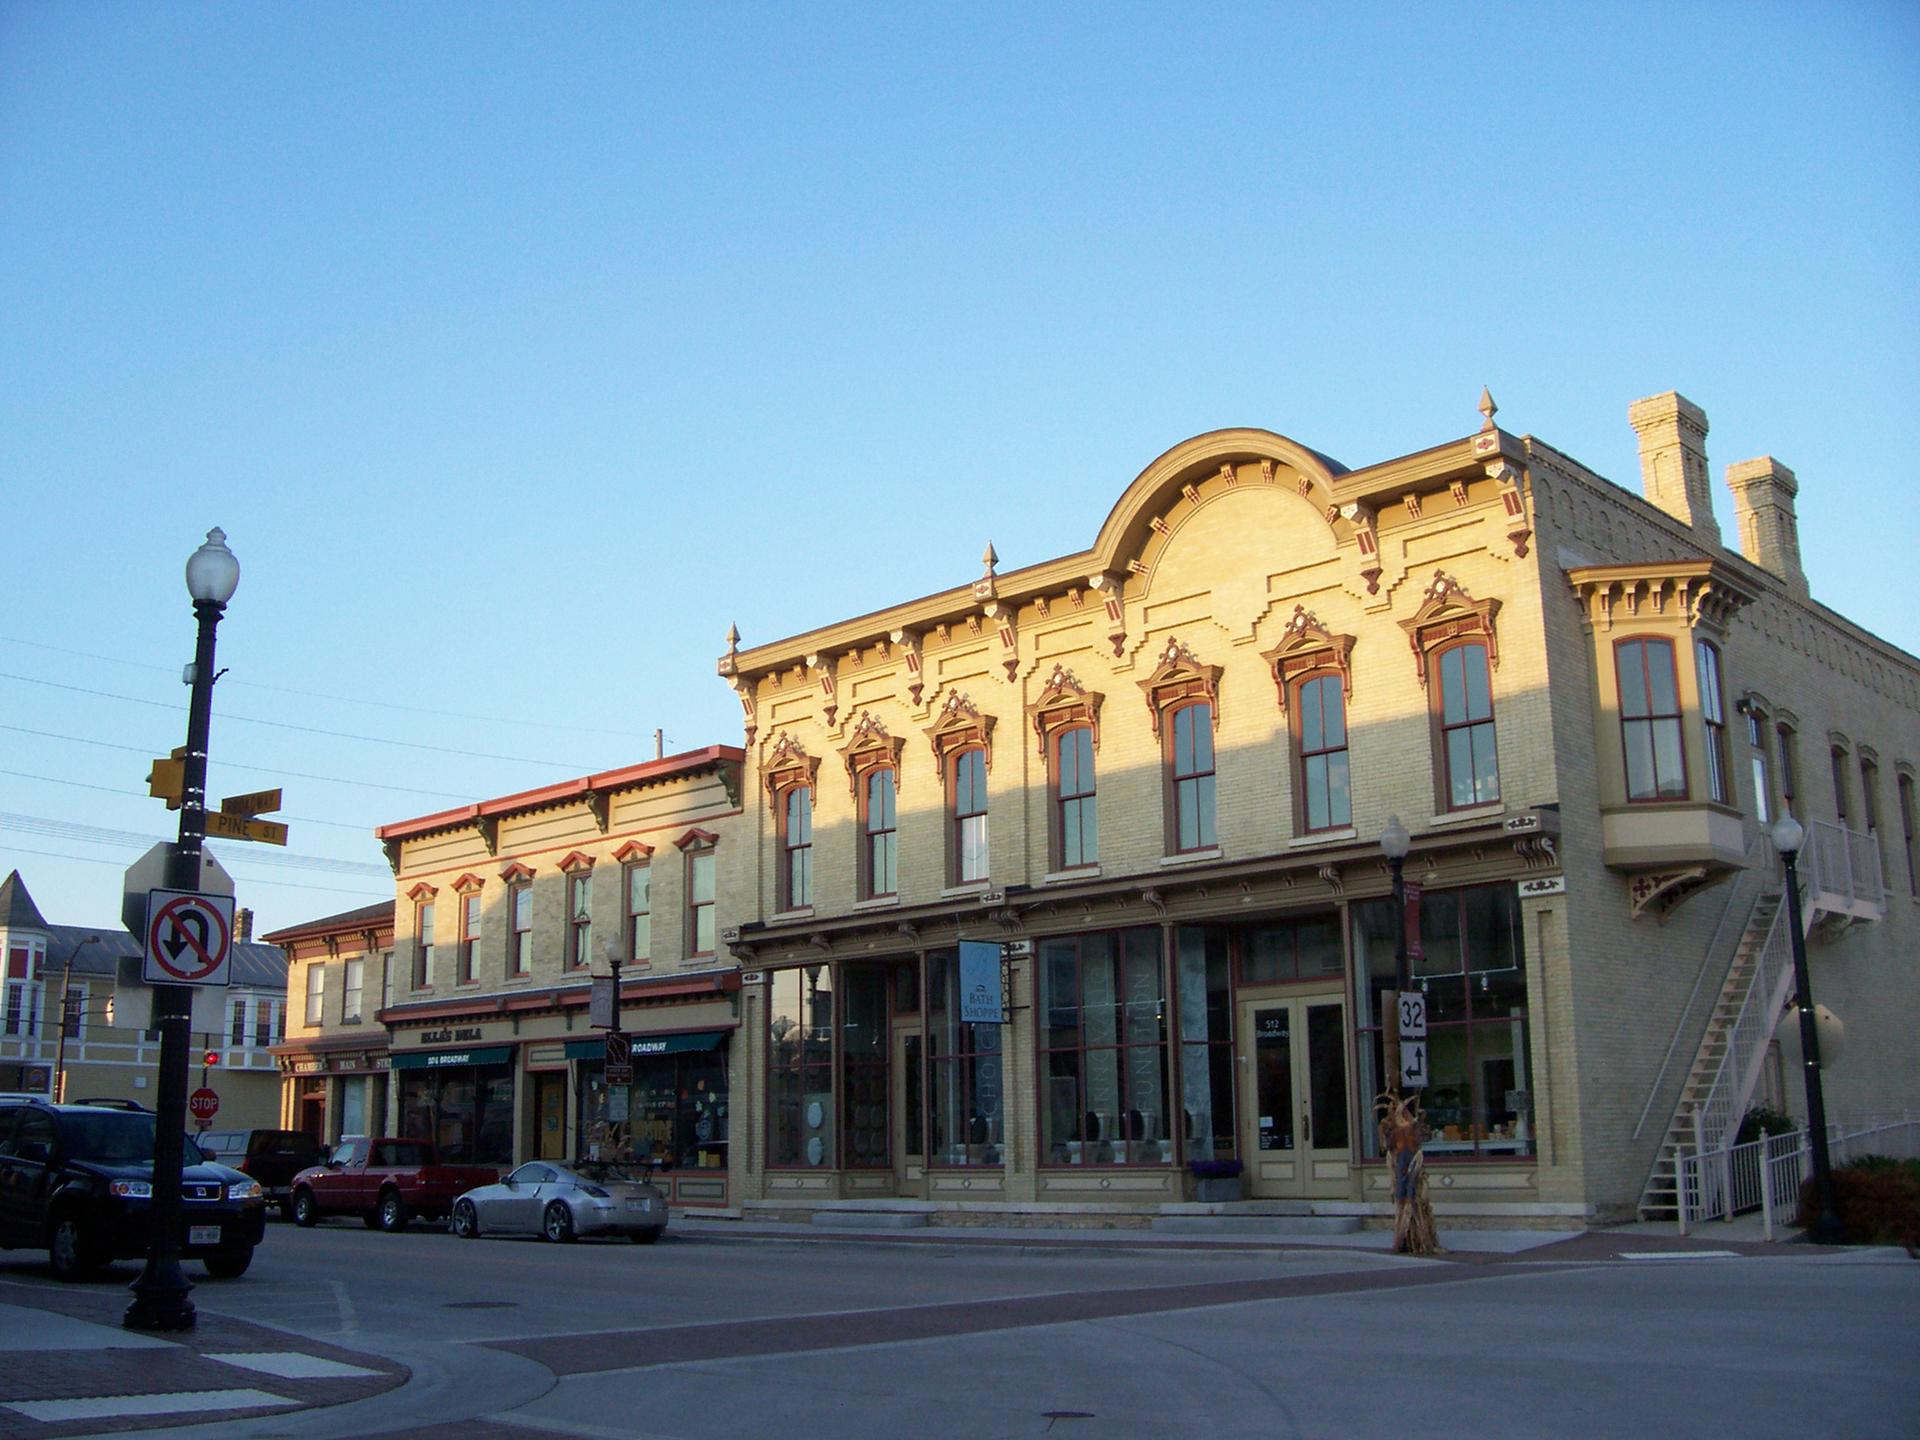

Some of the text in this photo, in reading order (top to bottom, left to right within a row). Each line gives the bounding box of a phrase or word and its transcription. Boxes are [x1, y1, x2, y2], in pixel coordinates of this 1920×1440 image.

[219, 816, 276, 839] PINE ST
[969, 993, 993, 1005] BATH
[964, 1006, 999, 1018] SHOPPE
[1402, 1001, 1423, 1028] 32
[1265, 1019, 1280, 1029] 512
[632, 1042, 667, 1053] ROADWAY
[1134, 973, 1153, 1113] FUNCTION
[440, 1054, 470, 1064] BROADWAY
[980, 1022, 997, 1115] CHOCE
[192, 1097, 218, 1109] STOP
